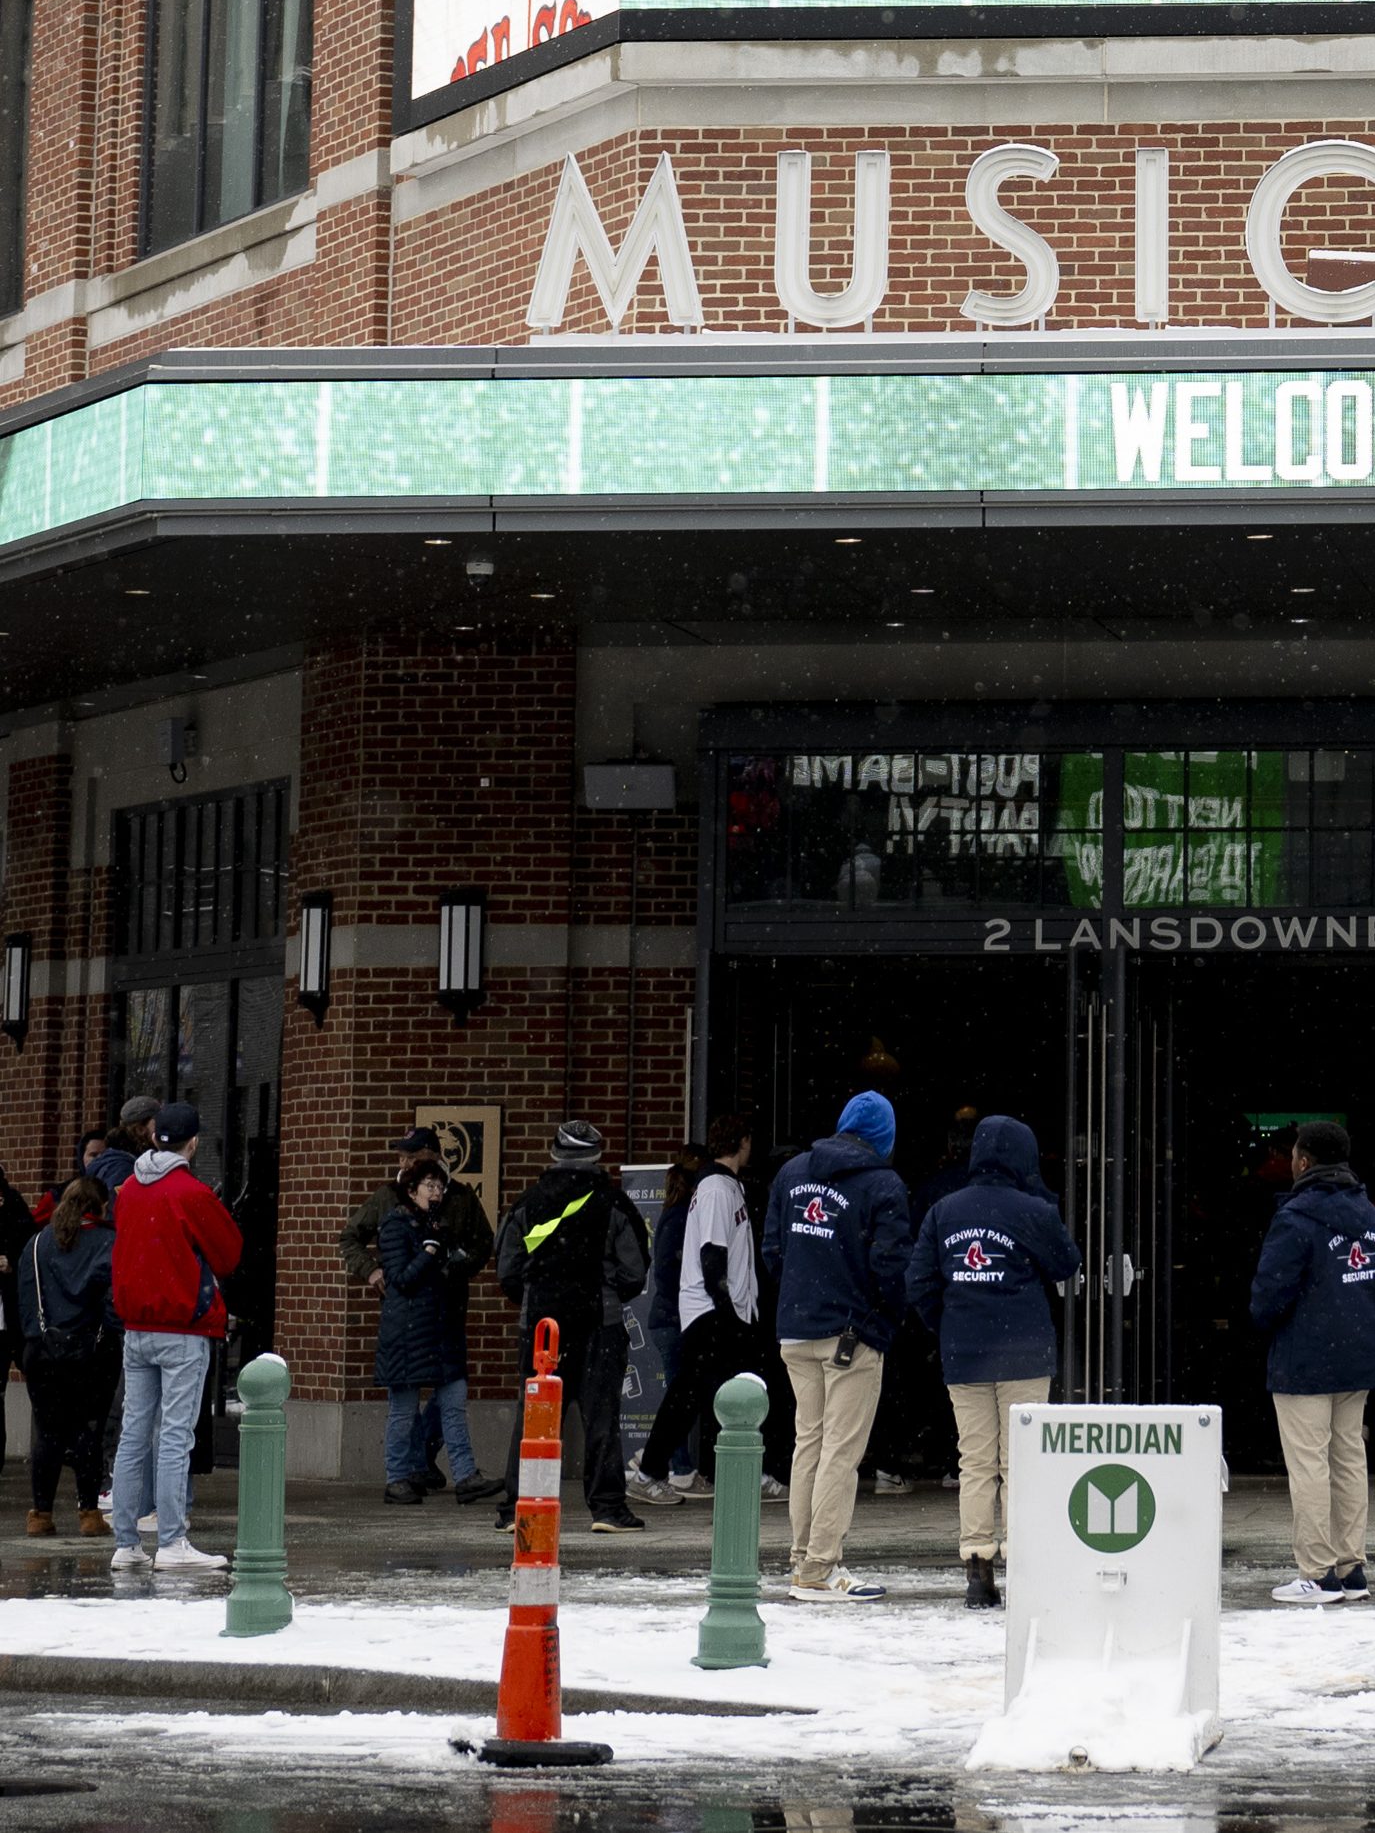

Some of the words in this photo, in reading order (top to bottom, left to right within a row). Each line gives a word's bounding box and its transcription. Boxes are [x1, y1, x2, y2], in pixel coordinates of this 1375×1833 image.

[983, 919, 1011, 951] 2
[789, 1183, 827, 1199] FENWAY
[827, 1188, 850, 1209] PARK
[791, 1223, 834, 1239] SECURITY
[944, 1228, 986, 1249] FENWAY
[987, 1230, 1015, 1250] PARK
[952, 1271, 1004, 1282] SECURITY
[1041, 1422, 1183, 1455] MERIDIAN
